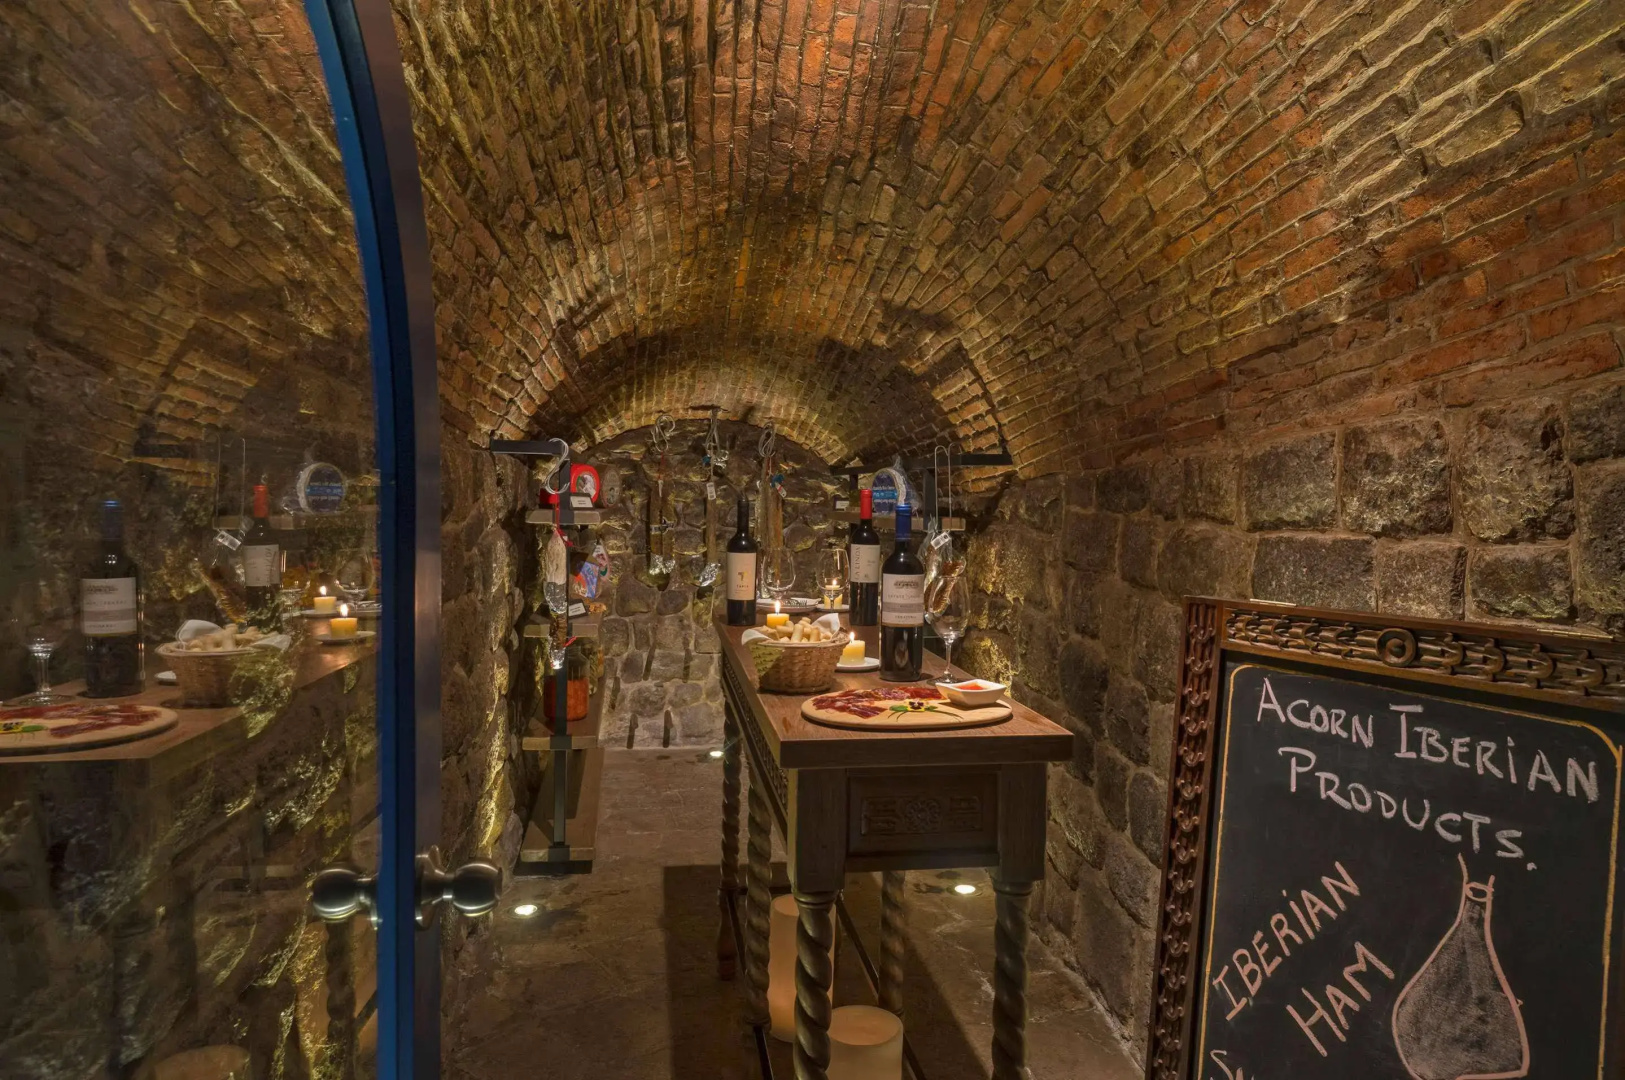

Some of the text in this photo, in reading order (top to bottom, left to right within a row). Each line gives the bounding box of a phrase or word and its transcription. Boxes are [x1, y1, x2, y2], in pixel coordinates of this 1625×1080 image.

[1257, 678, 1374, 748] ACORN
[1278, 746, 1537, 871] PRODUCTS.
[1286, 941, 1395, 1057] HAM
